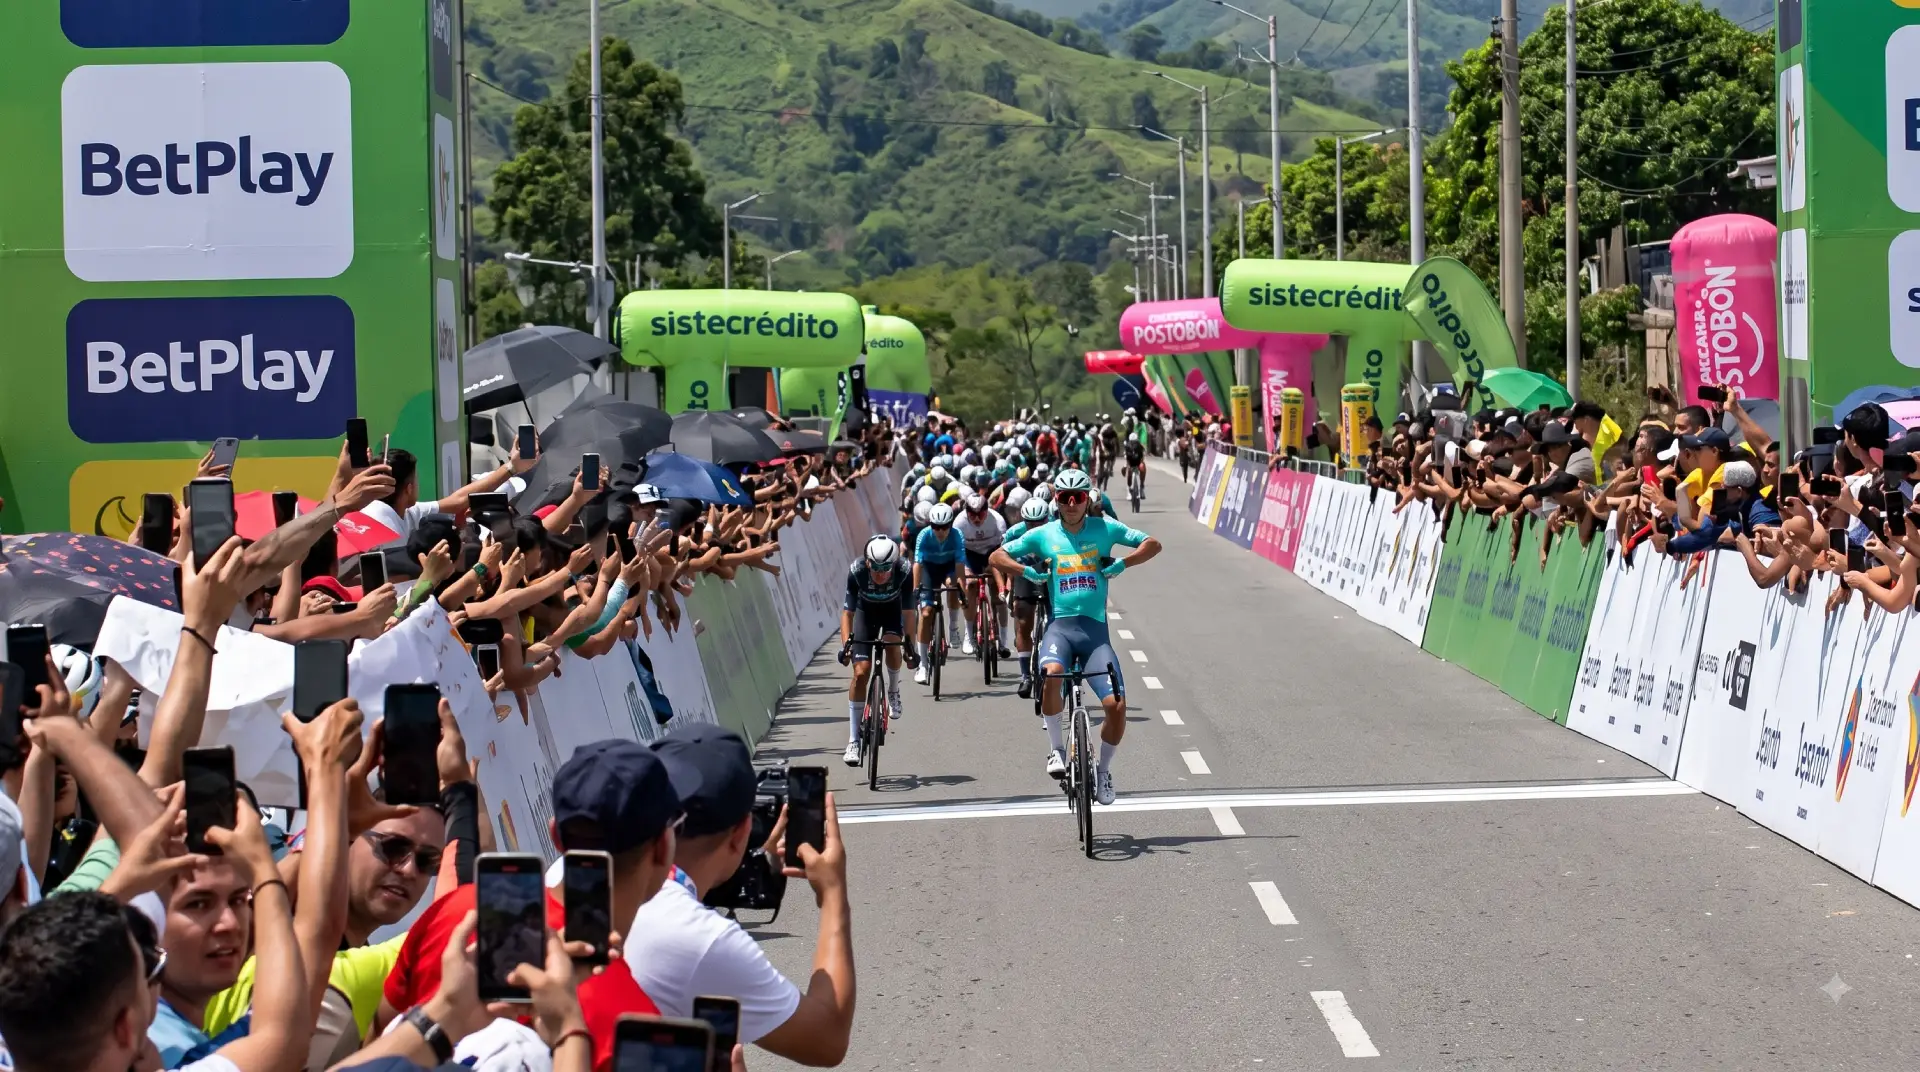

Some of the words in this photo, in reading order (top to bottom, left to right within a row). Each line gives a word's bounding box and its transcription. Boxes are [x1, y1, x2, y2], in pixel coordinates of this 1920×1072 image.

[80, 135, 334, 206] BetPlay
[1248, 282, 1403, 312] sistecrédit
[650, 310, 839, 340] sistecrédito
[86, 333, 335, 403] BetPlay
